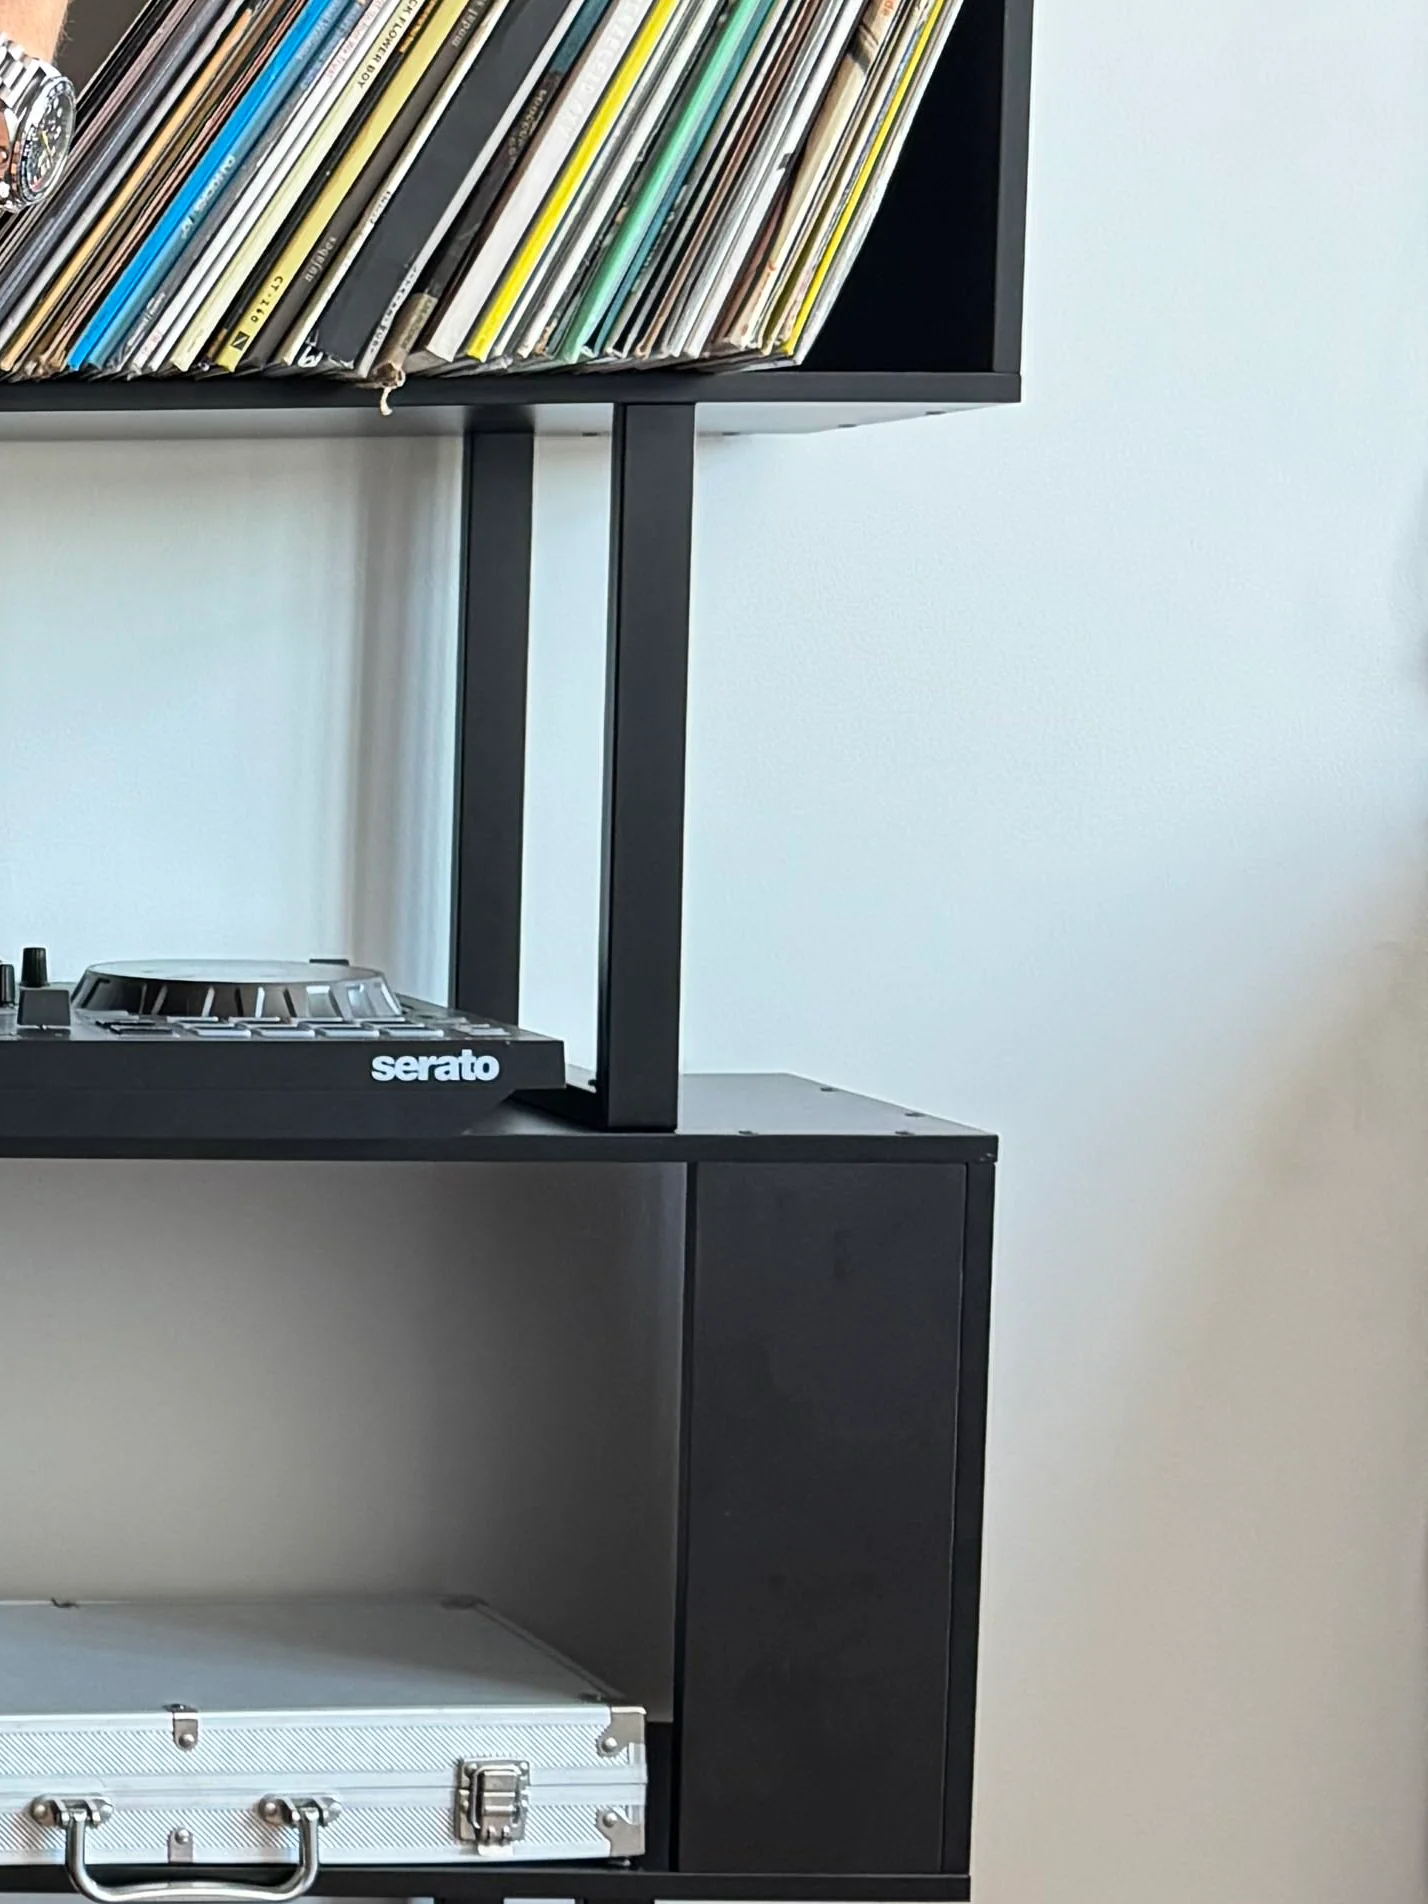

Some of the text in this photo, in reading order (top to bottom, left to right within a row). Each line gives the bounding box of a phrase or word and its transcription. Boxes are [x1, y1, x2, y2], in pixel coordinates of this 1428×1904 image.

[373, 18, 406, 64] FLOWER
[451, 9, 477, 48] modal
[357, 64, 376, 89] BOY
[304, 236, 338, 282] nujabes
[371, 1050, 500, 1082] serato
